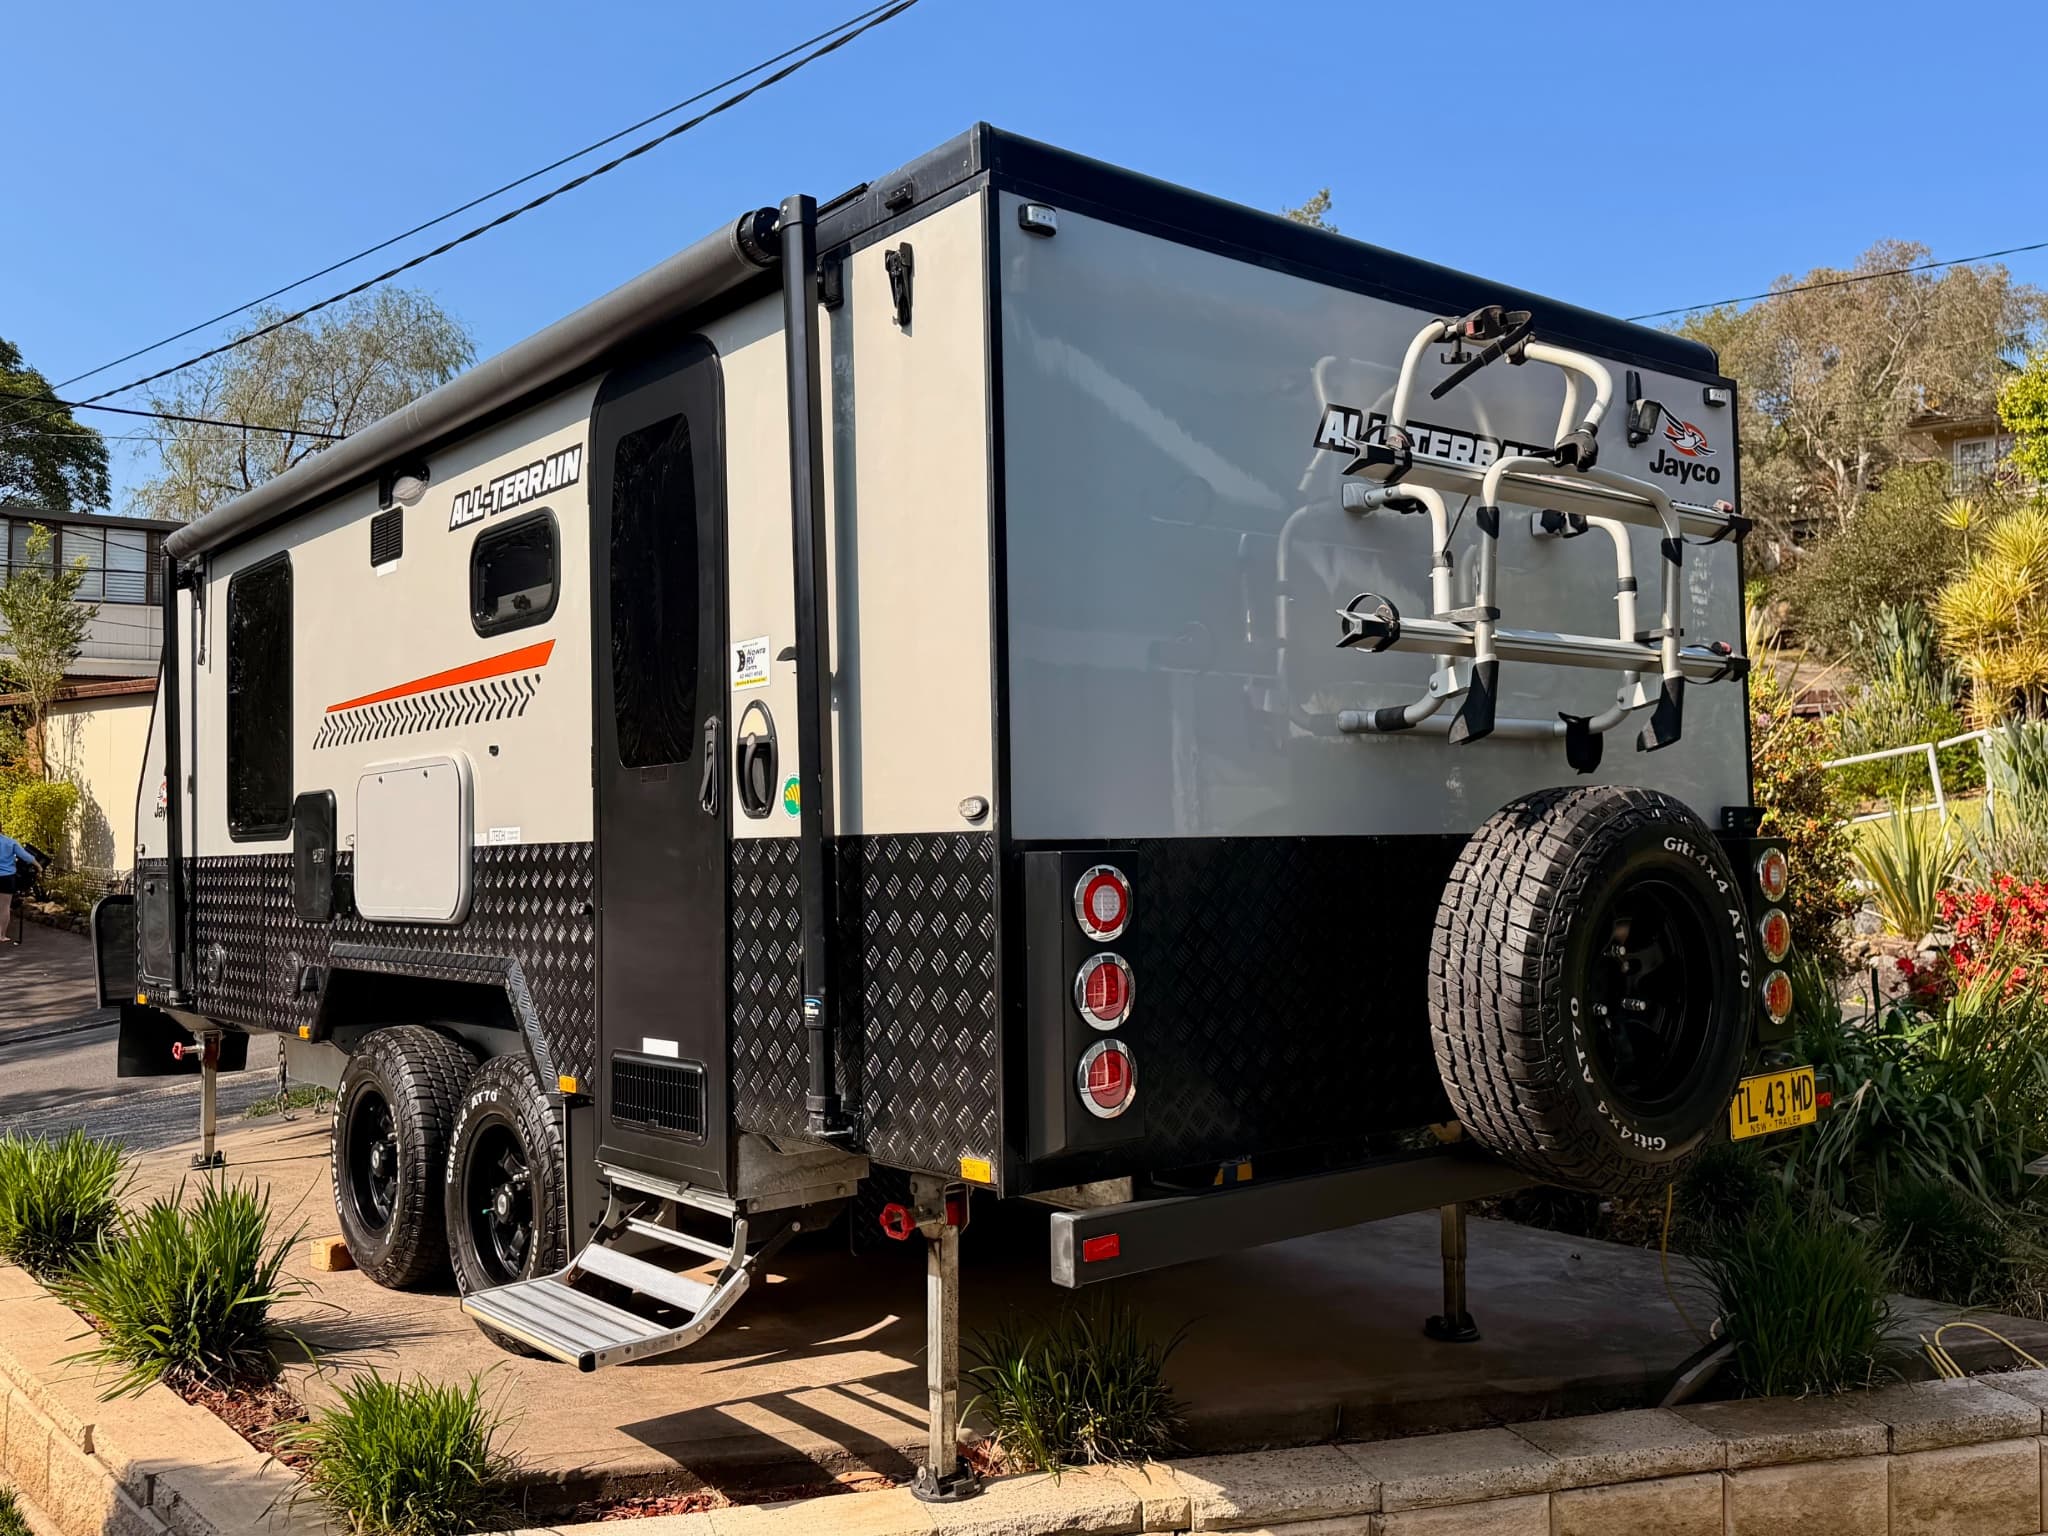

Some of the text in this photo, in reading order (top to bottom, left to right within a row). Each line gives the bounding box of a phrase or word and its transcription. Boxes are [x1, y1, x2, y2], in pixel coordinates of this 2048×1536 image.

[449, 443, 582, 532] ALL-TERRAIN
[1649, 449, 1720, 485] Jayco
[154, 802, 168, 821] Jay
[1727, 908, 1750, 988] AT70
[1570, 997, 1594, 1083] AT70
[471, 1090, 497, 1110] AT70
[1736, 1074, 1813, 1125] TL 43 MD
[1750, 1114, 1801, 1134] NSW TRAILER
